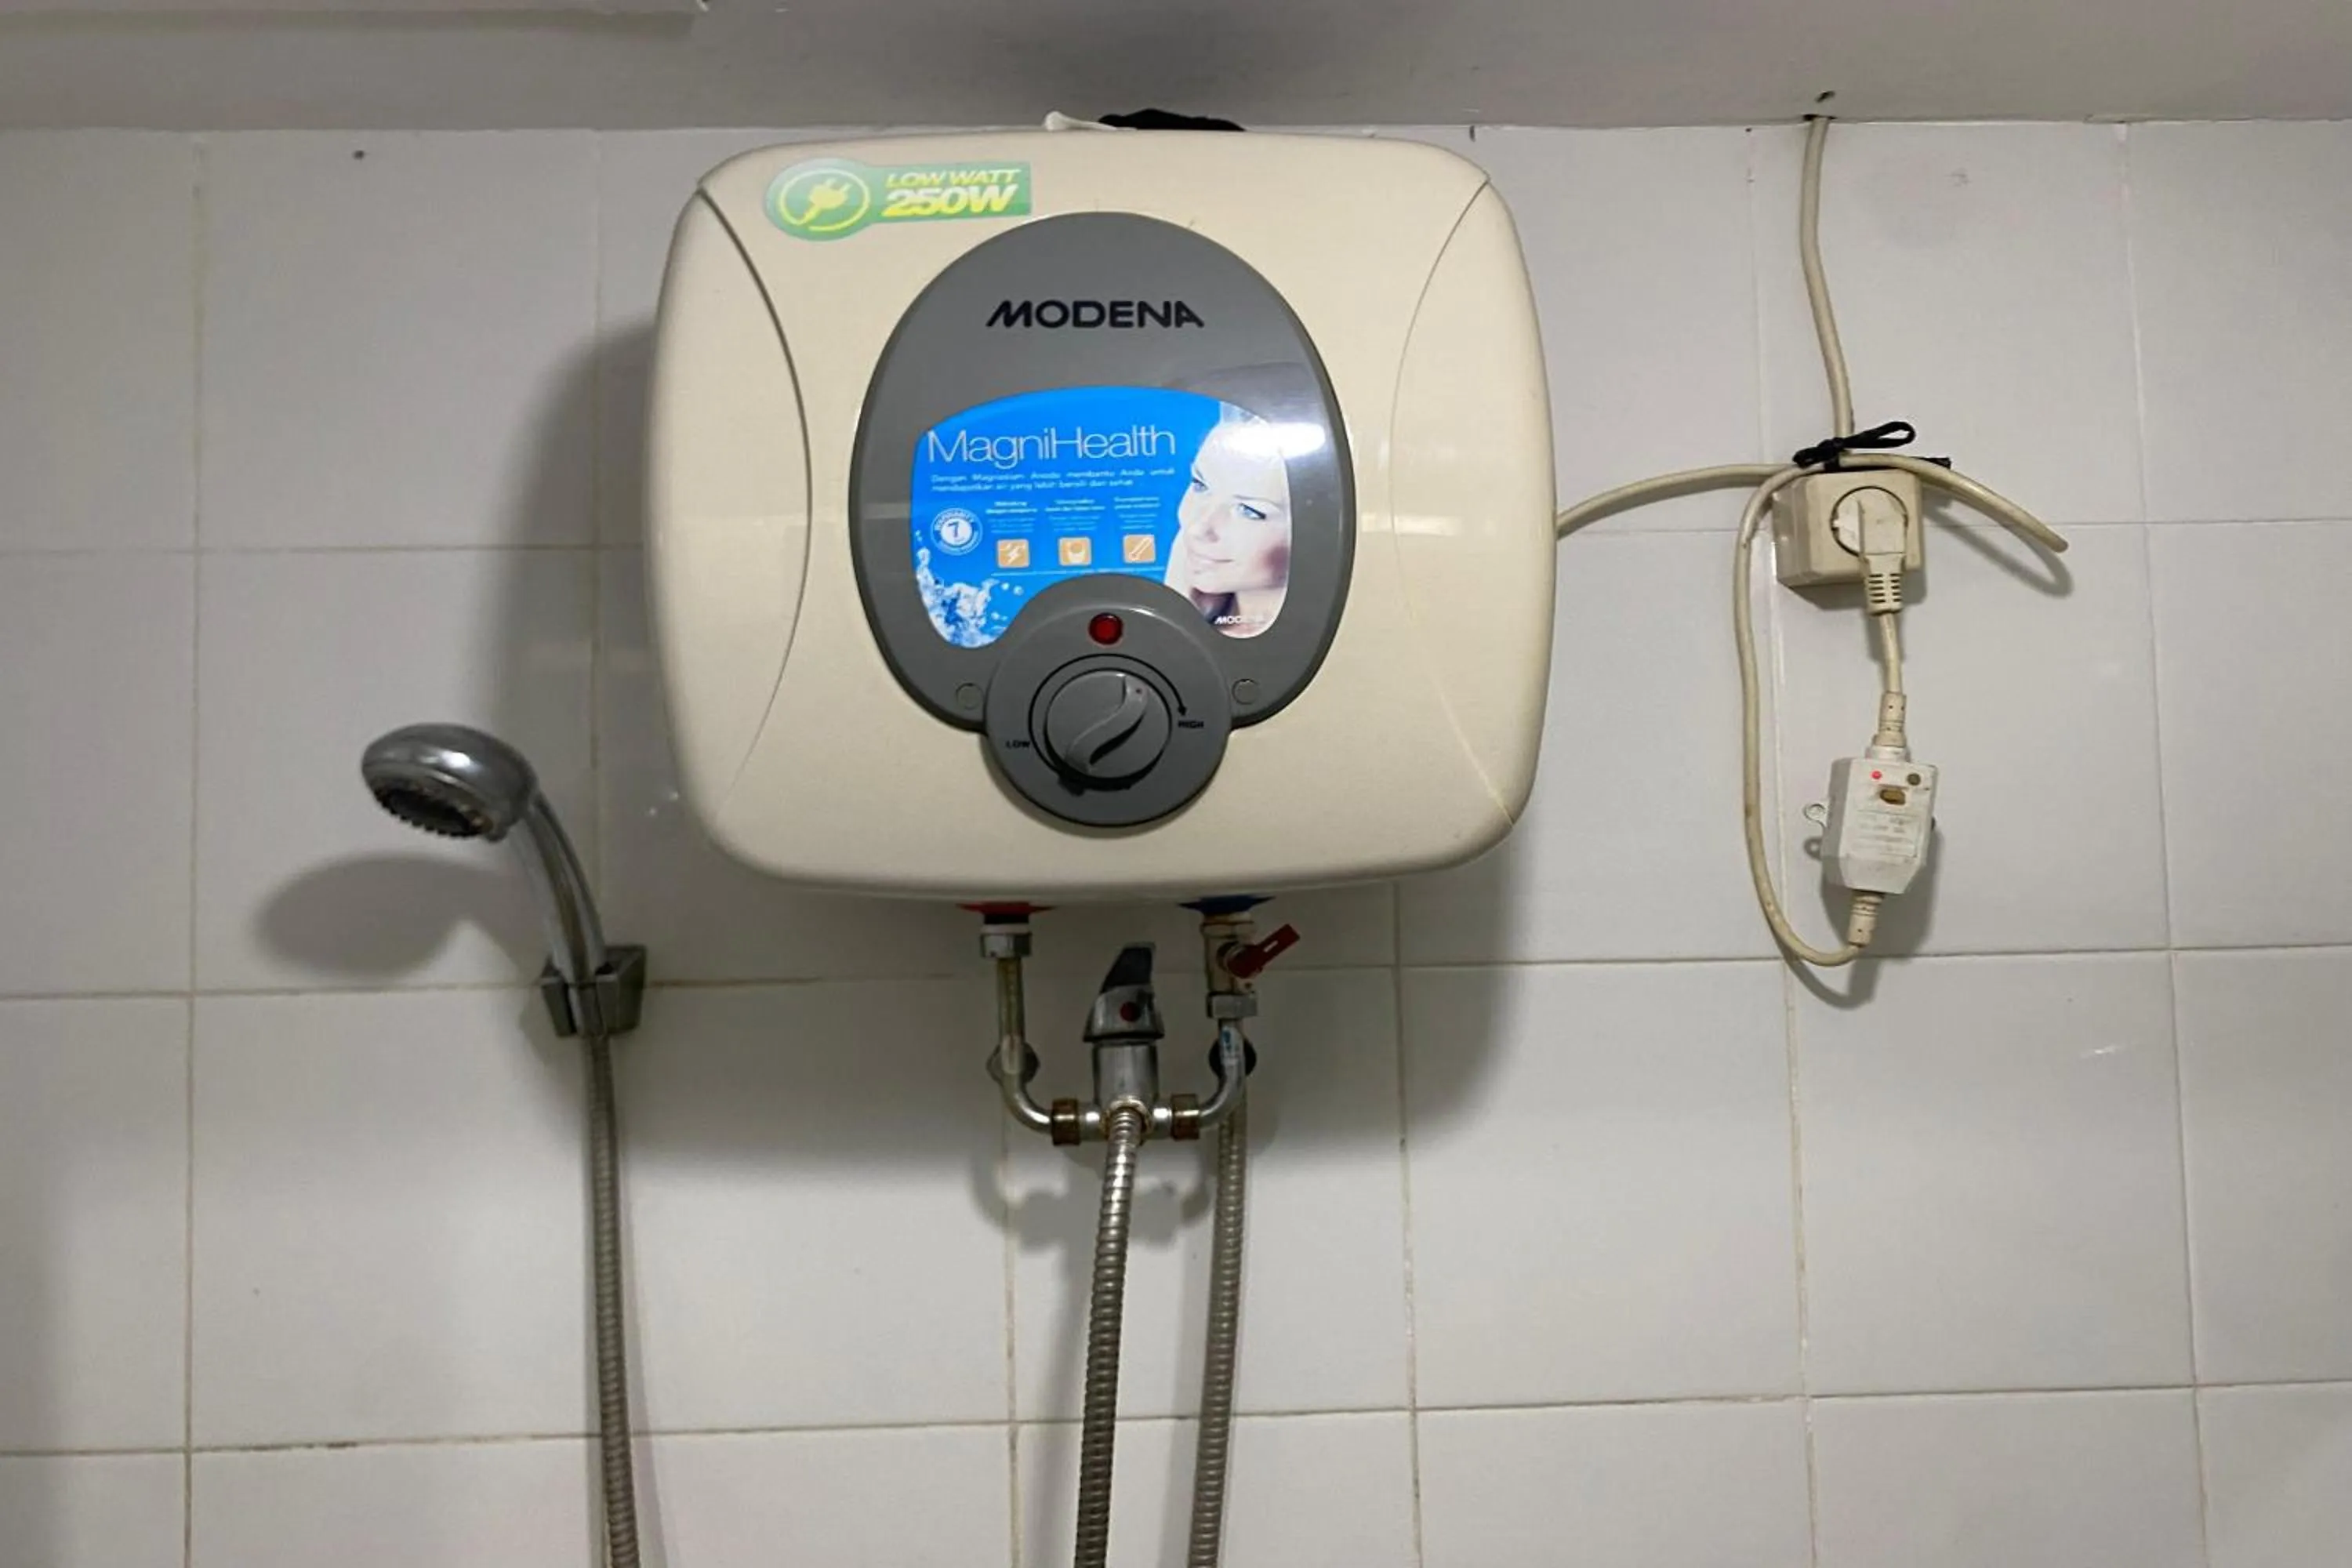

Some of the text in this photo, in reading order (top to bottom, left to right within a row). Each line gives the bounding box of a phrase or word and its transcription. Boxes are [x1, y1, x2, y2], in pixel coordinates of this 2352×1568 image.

[885, 168, 1022, 188] LOW WATT
[881, 183, 1019, 217] 250W
[985, 299, 1205, 328] MODENA
[927, 425, 1176, 470] MagniHealth
[1178, 720, 1204, 729] HIGH
[1006, 740, 1030, 749] LOW
